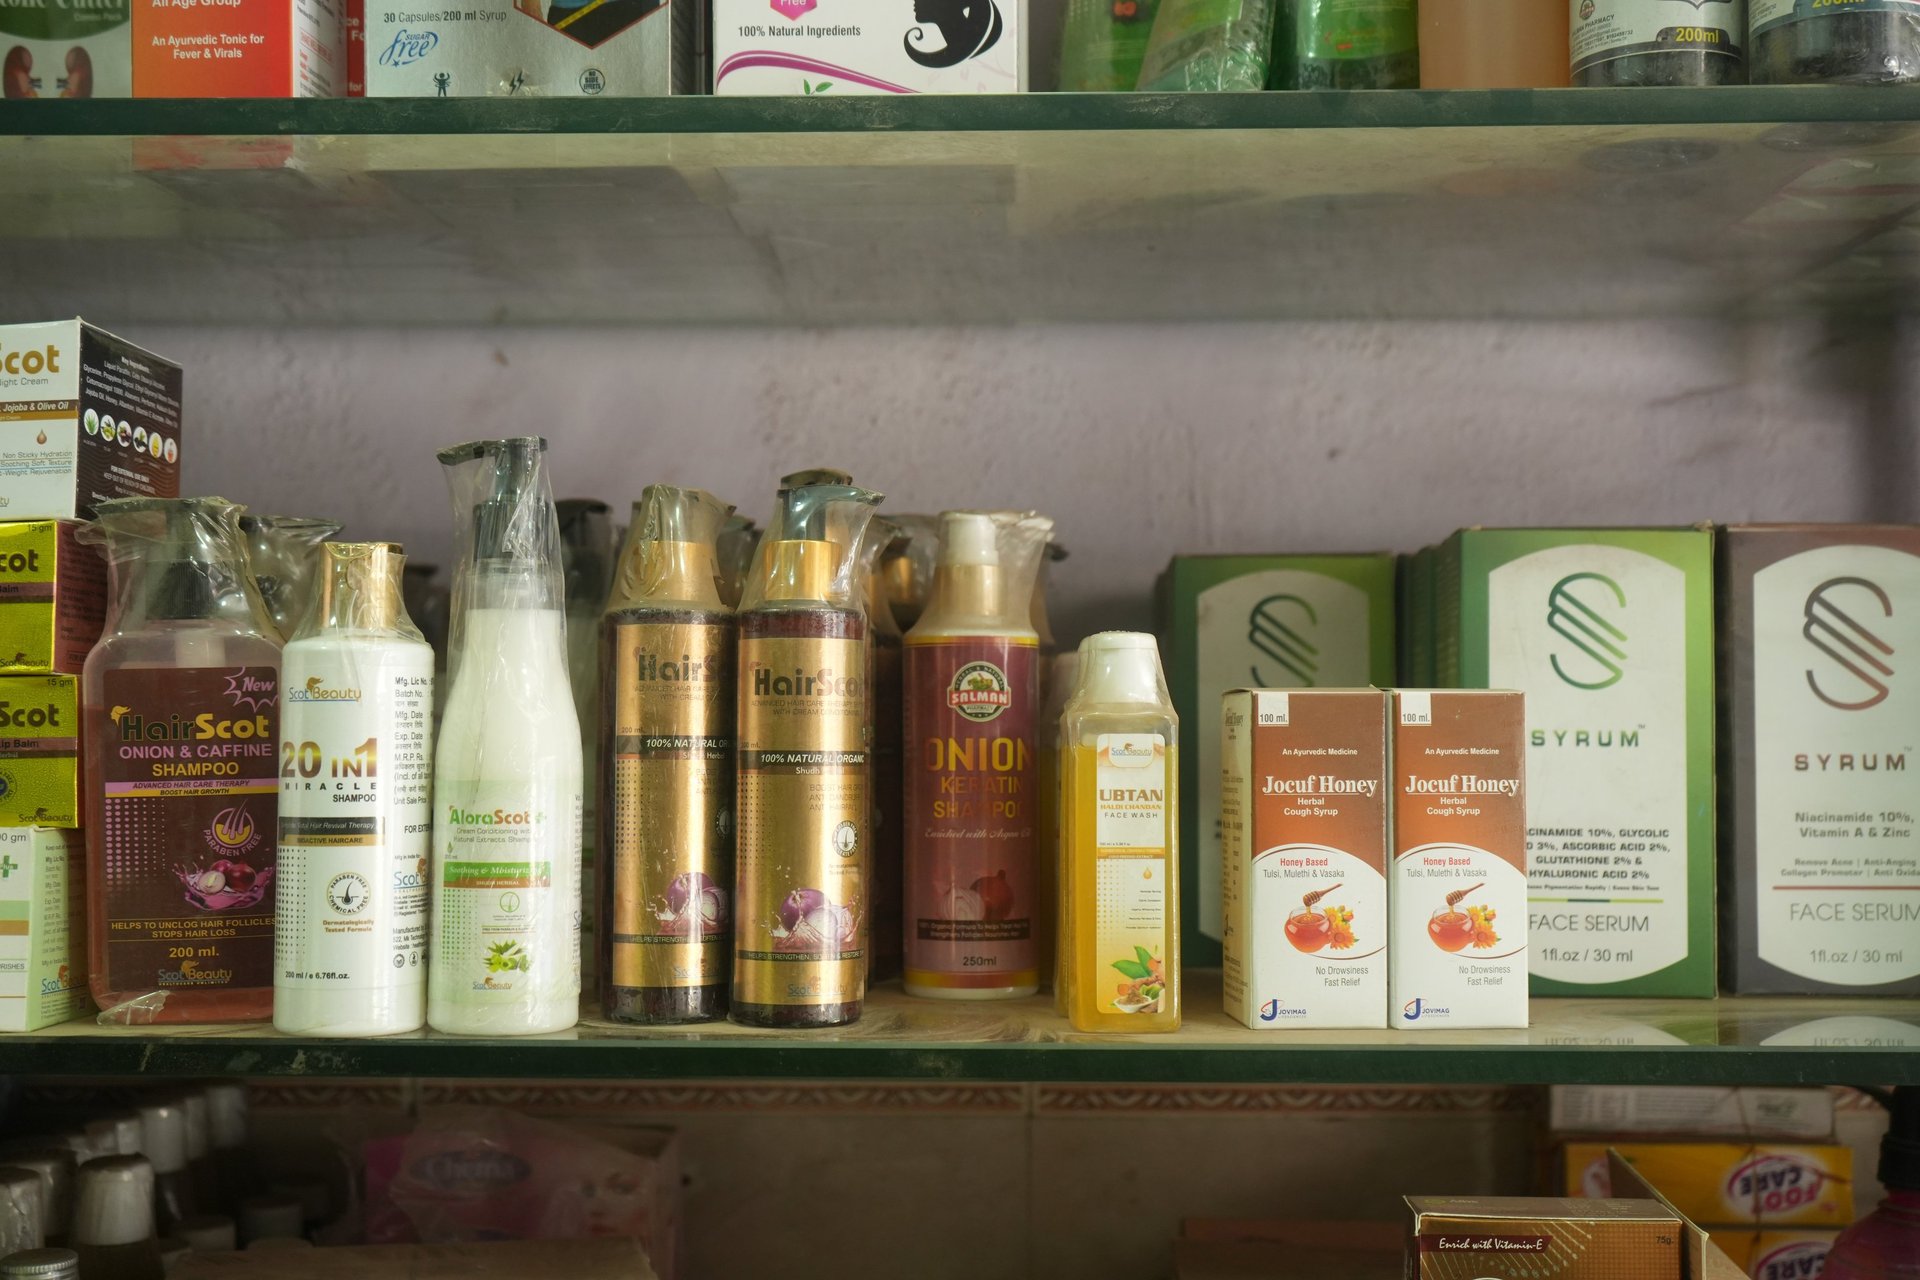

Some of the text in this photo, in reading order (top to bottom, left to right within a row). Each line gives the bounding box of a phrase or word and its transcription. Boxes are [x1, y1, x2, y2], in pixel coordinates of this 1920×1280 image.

[383, 12, 396, 23] 30
[464, 10, 477, 22] ml
[479, 10, 507, 23] Syrup
[405, 32, 431, 42] SUGAR
[738, 24, 861, 39] 100% Natural Ingredients
[1675, 27, 1719, 44] 200ml
[151, 33, 265, 48] An Ayurvedic Tonic for
[173, 47, 243, 60] Fever & Virals
[21, 377, 49, 386] Cream
[3, 402, 69, 413] Jojoba Olive Oil
[18, 450, 73, 460] Sticky Hydration
[31, 458, 72, 467] Soft Texture
[30, 467, 72, 476] Rejuvenation
[58, 679, 73, 688] gm
[242, 676, 275, 692] New
[754, 667, 864, 698] HairSco
[289, 686, 362, 701] Scot Beauty
[951, 691, 1008, 705] SALMAN
[1259, 713, 1274, 723] 100
[1402, 713, 1417, 723] 100
[121, 712, 270, 742] HairScot
[13, 739, 39, 748] Balm
[646, 738, 718, 748] 100% NATURAL
[1531, 729, 1640, 747] SYRUM
[119, 743, 272, 760] ONION & CAFFINE
[1282, 748, 1293, 756] An
[1293, 748, 1327, 757] Ayurvedic
[1436, 748, 1469, 756] Ayurvedic
[280, 740, 322, 779] 20
[760, 753, 835, 764] 100% NATURAL
[1794, 753, 1906, 771] SYRUM
[152, 761, 240, 777] SHAMPOO
[132, 781, 173, 790] ADVANCED
[173, 781, 192, 789] HAIR
[213, 780, 251, 788] THERAPY
[285, 782, 377, 791] MIRACLE
[1262, 774, 1378, 798] Jocuf Honey
[1405, 774, 1520, 797] Jocuf Honey
[332, 793, 377, 803] SHAMPOO
[1099, 788, 1164, 802] UBTAN
[1297, 797, 1325, 805] Herbal
[1440, 797, 1467, 805] Herbal
[1284, 807, 1339, 817] Cough Syrup
[1427, 807, 1481, 816] Cough Syrup
[19, 813, 38, 823] Scot
[1794, 811, 1915, 824] Niacinamide 10%,
[348, 822, 375, 830] Therapy
[966, 828, 988, 839] with
[1587, 828, 1616, 839] 10%,
[1618, 828, 1670, 838] GLYCOLIC
[1799, 826, 1911, 838] Vitamin A Zinc
[203, 829, 240, 857] PARABEN
[1537, 842, 1671, 853] 3%, ASCORBIC ACID 2%,
[1280, 857, 1329, 868] Honey Based
[1423, 857, 1471, 867] Honey Based
[1535, 856, 1632, 866] GLUTATHIONE 2%
[1263, 868, 1345, 879] Tulsi, Mulethi & Vasaka
[1406, 868, 1487, 878] Tulsi, Mulethi & Vasaka
[1529, 869, 1650, 880] HYALURONIC ACID 2%
[394, 871, 419, 887] Scot
[329, 895, 356, 914] CHEMICAL
[1789, 902, 1920, 922] FACE SERUM
[111, 917, 277, 930] HELPS TO UNCLOG HAIR FOLLICLES
[1529, 914, 1650, 932] FACE SERUM
[152, 928, 236, 938] STOPS HAIR LOSS
[169, 947, 194, 958] 200
[1593, 949, 1612, 962] 30
[1616, 949, 1634, 962] ml
[1862, 950, 1881, 964] 30
[1885, 950, 1904, 963] ml
[962, 956, 997, 967] 250ml
[158, 968, 233, 983] Scot Beauty
[1315, 966, 1369, 975] No Drowsiness
[1458, 965, 1511, 975] No Drowsiness
[41, 976, 60, 993] Scot
[1324, 977, 1361, 987] Fast Relief
[1467, 976, 1503, 986] Fast Relief
[1278, 1008, 1307, 1016] JOVIMAG
[1439, 1236, 1543, 1251] Enrich with Vitamin-E
